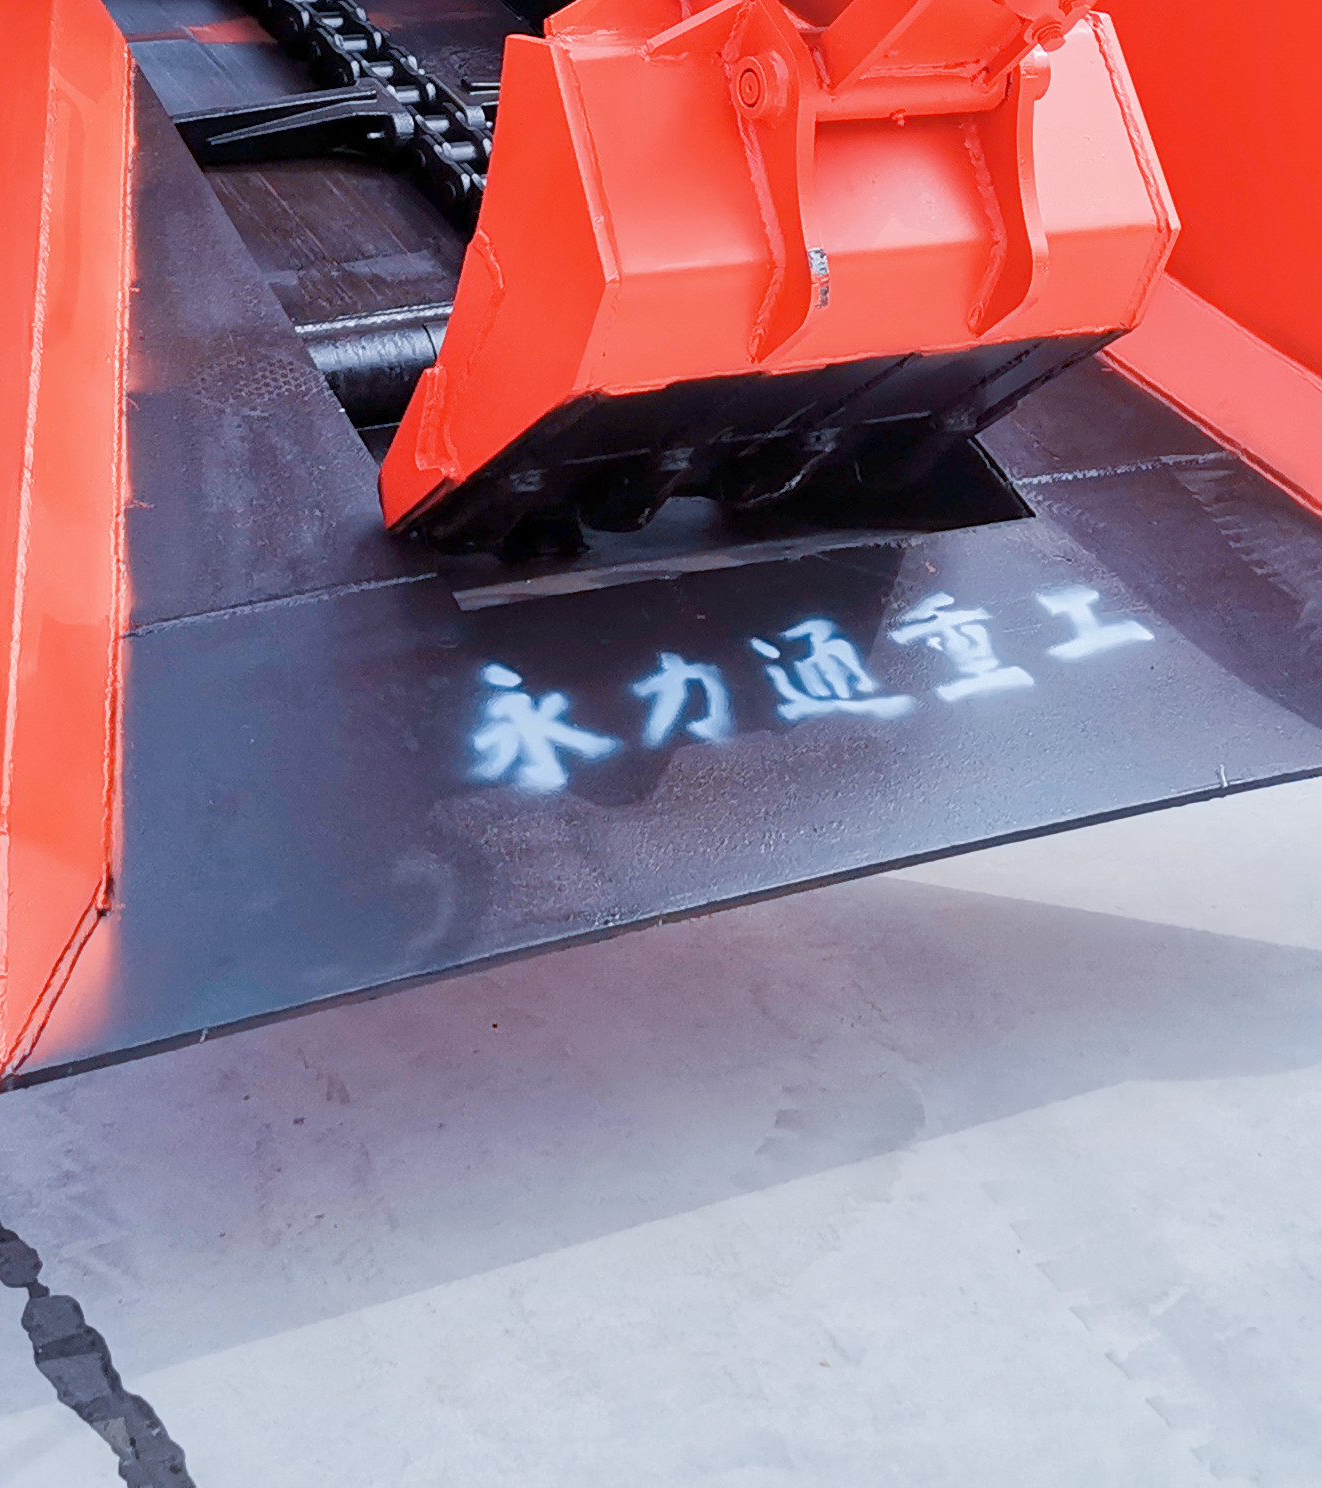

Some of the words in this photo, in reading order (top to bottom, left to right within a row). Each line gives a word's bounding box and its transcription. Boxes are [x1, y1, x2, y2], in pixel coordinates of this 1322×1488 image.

[473, 586, 1156, 794] 永力通重工
